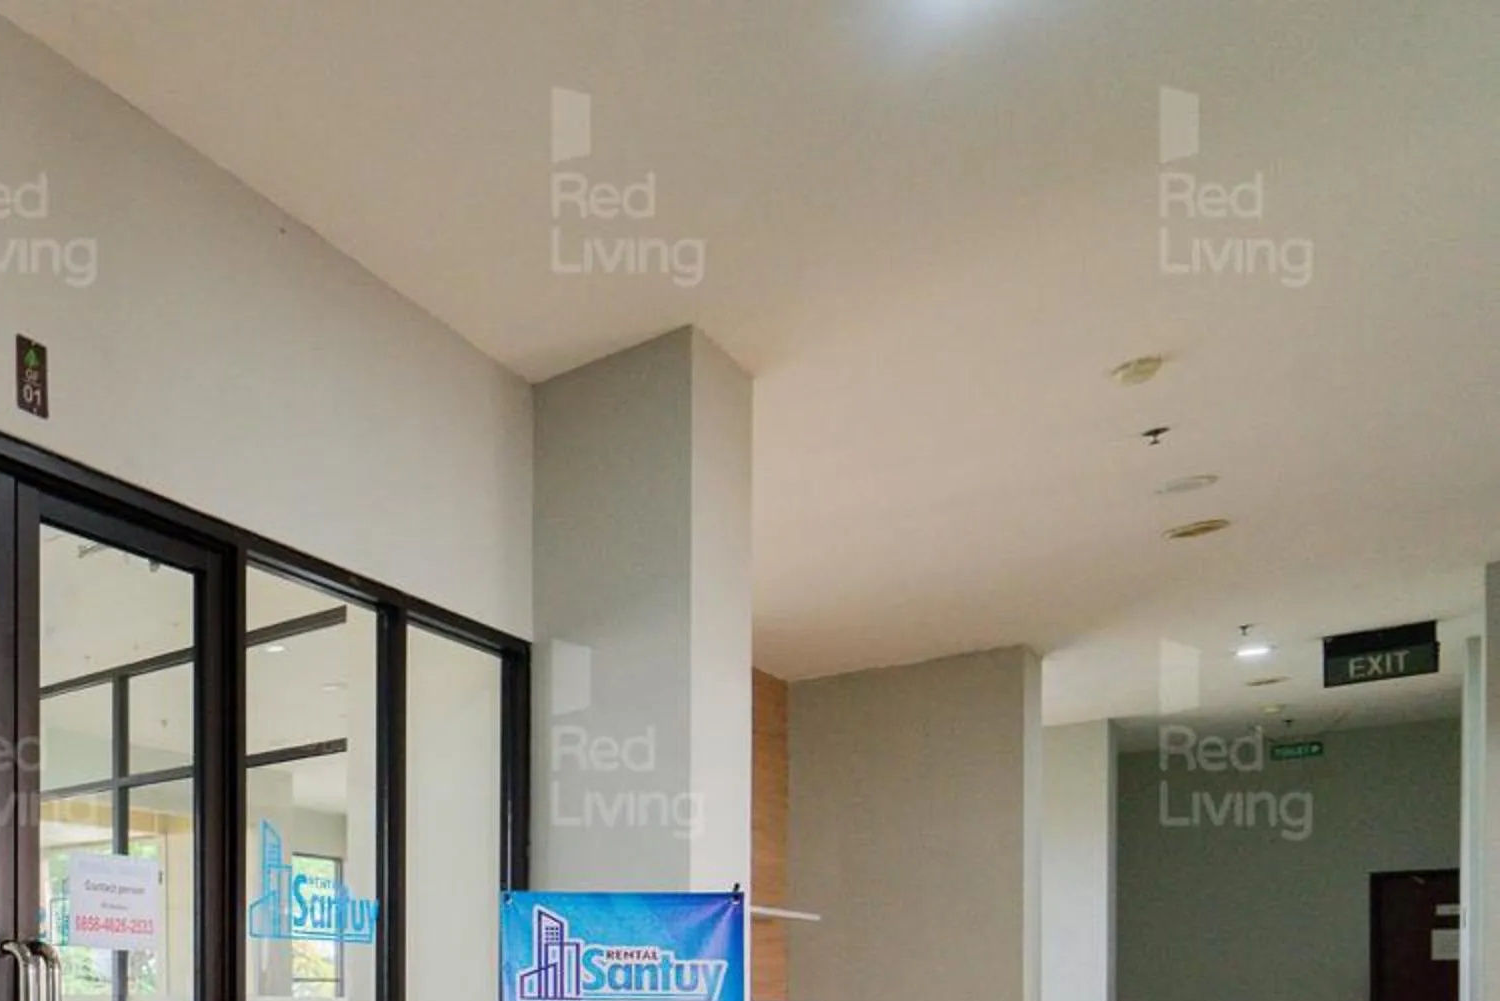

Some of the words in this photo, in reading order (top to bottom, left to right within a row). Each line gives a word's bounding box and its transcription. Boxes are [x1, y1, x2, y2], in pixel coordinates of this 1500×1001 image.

[23, 384, 42, 405] 01
[1350, 650, 1411, 679] EXIT
[293, 874, 379, 940] Santuy
[606, 950, 658, 960] RENTAL
[582, 948, 723, 1001] Santuy
